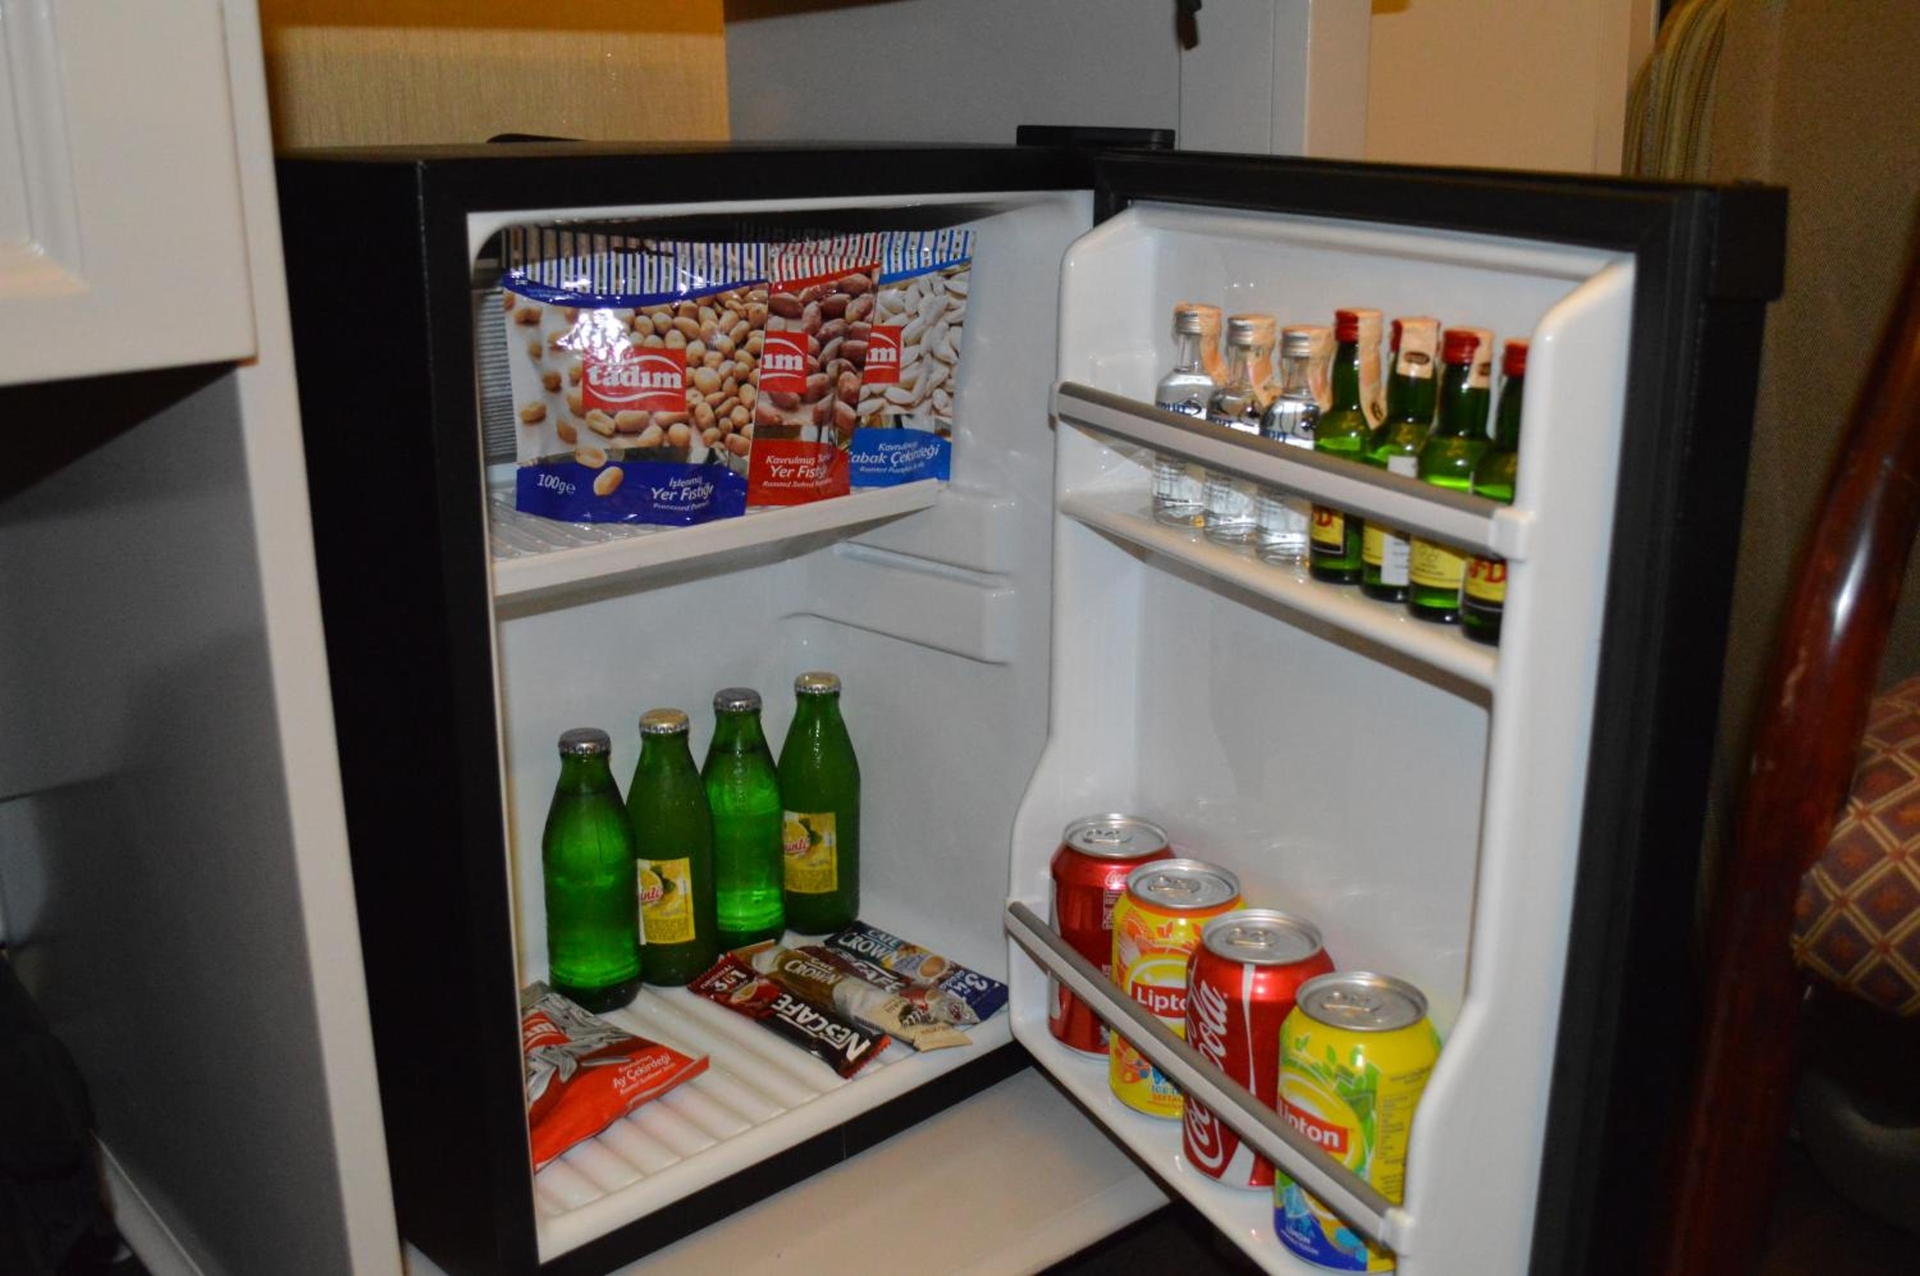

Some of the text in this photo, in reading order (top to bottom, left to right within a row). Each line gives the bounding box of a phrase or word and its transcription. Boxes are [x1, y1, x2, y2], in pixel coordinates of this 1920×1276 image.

[848, 450, 888, 464] abak
[770, 465, 795, 479] Yer
[651, 487, 678, 501] Yer
